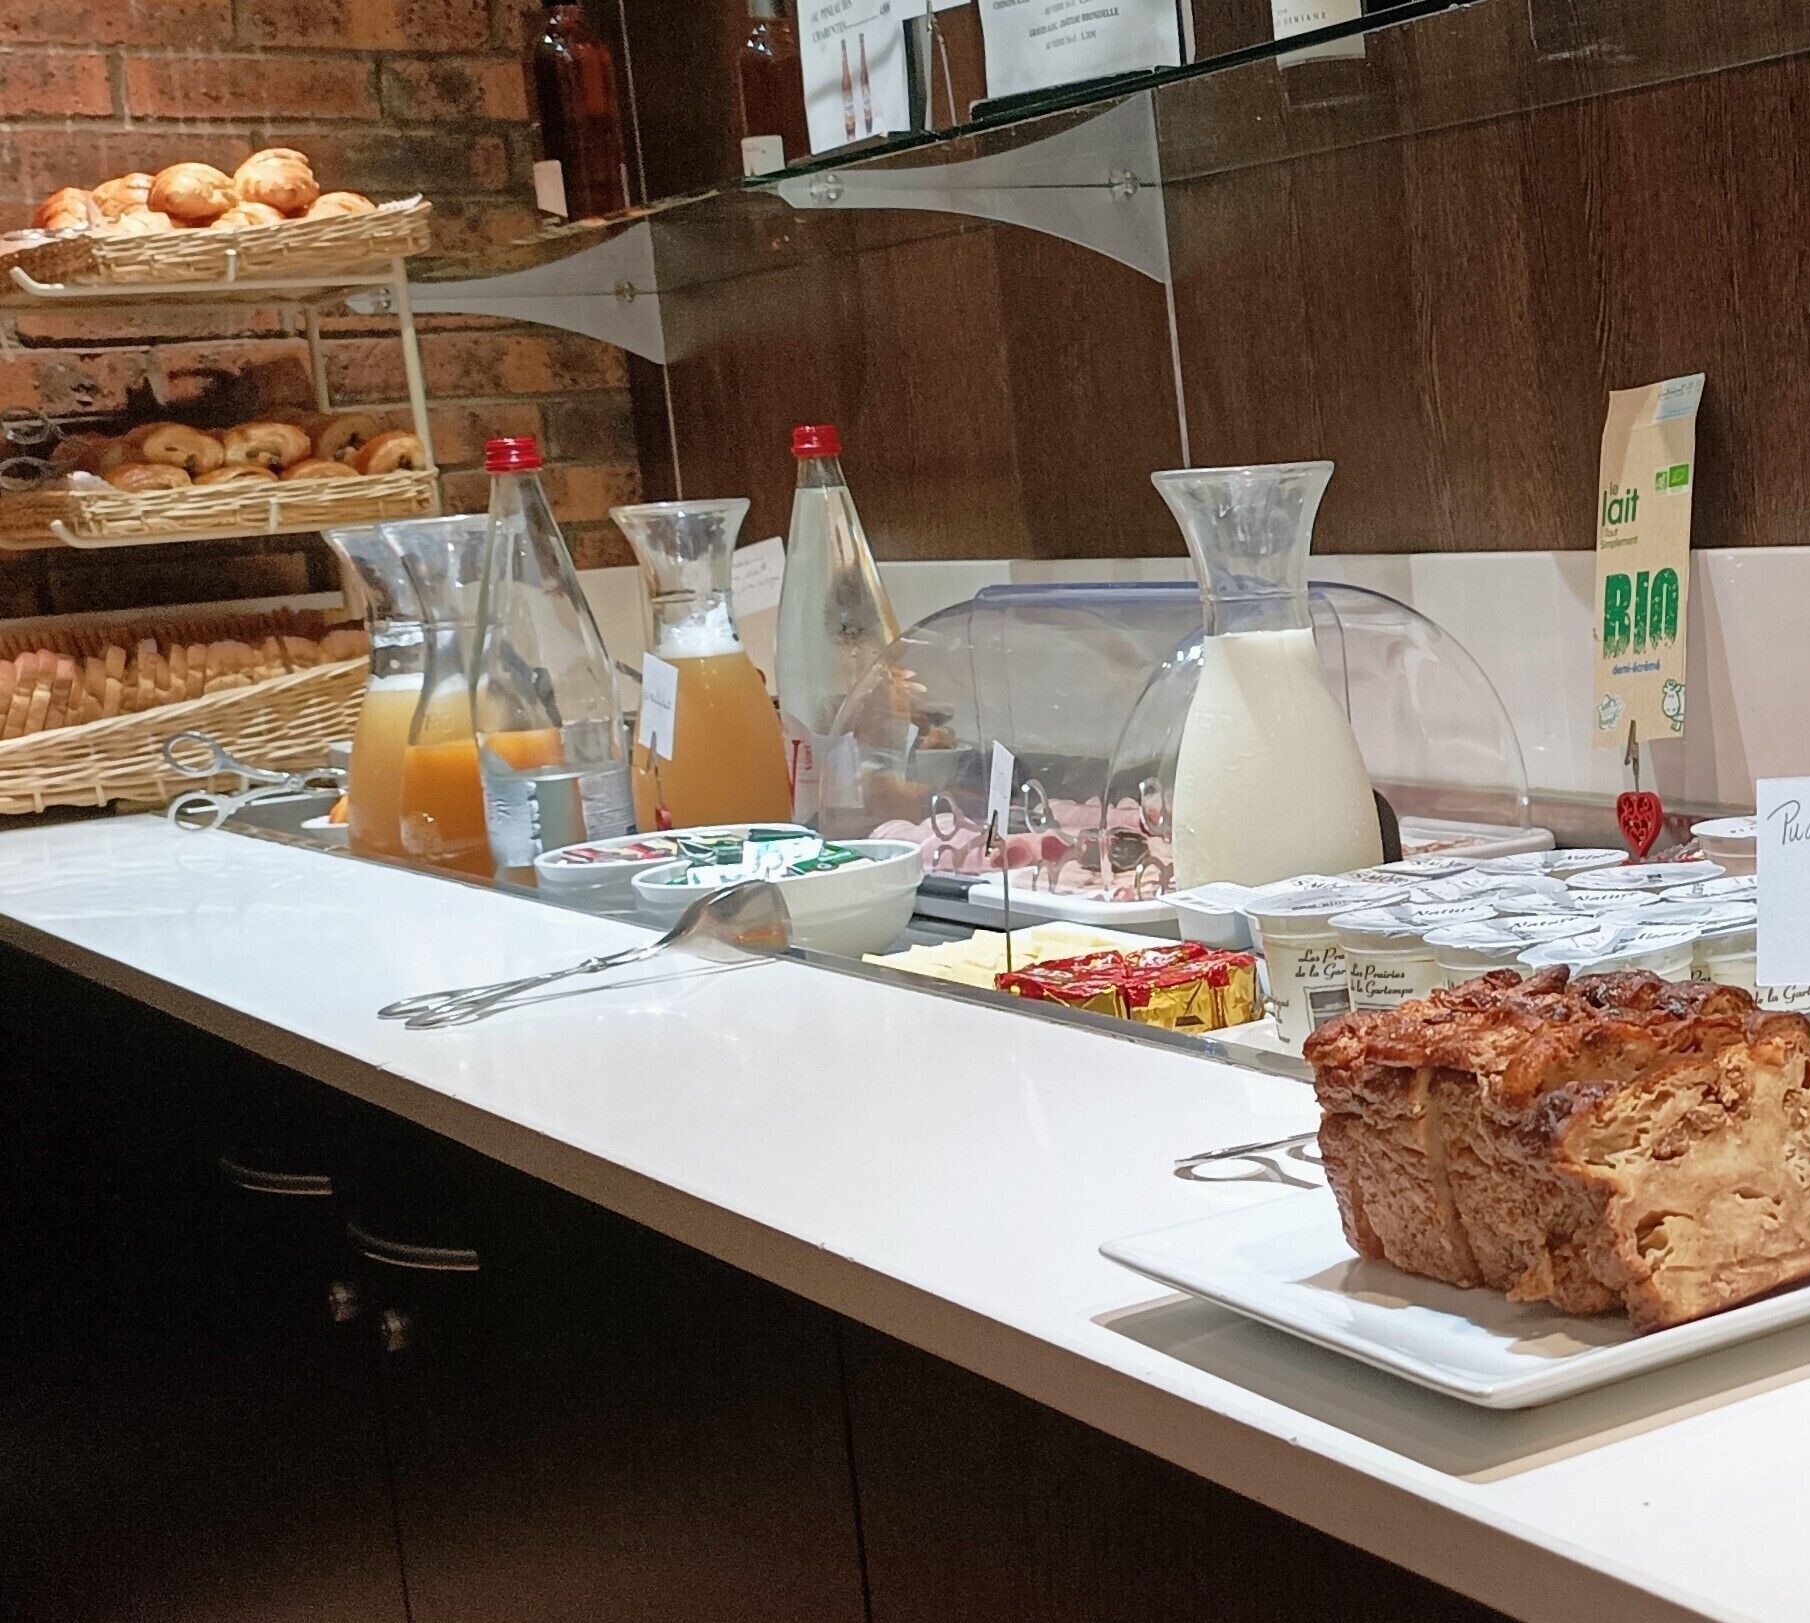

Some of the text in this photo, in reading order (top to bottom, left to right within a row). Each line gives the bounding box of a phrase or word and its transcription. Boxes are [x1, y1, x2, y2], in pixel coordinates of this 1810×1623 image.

[1601, 487, 1640, 528] lait
[1602, 566, 1680, 658] BIO
[1364, 964, 1406, 980] Prairies
